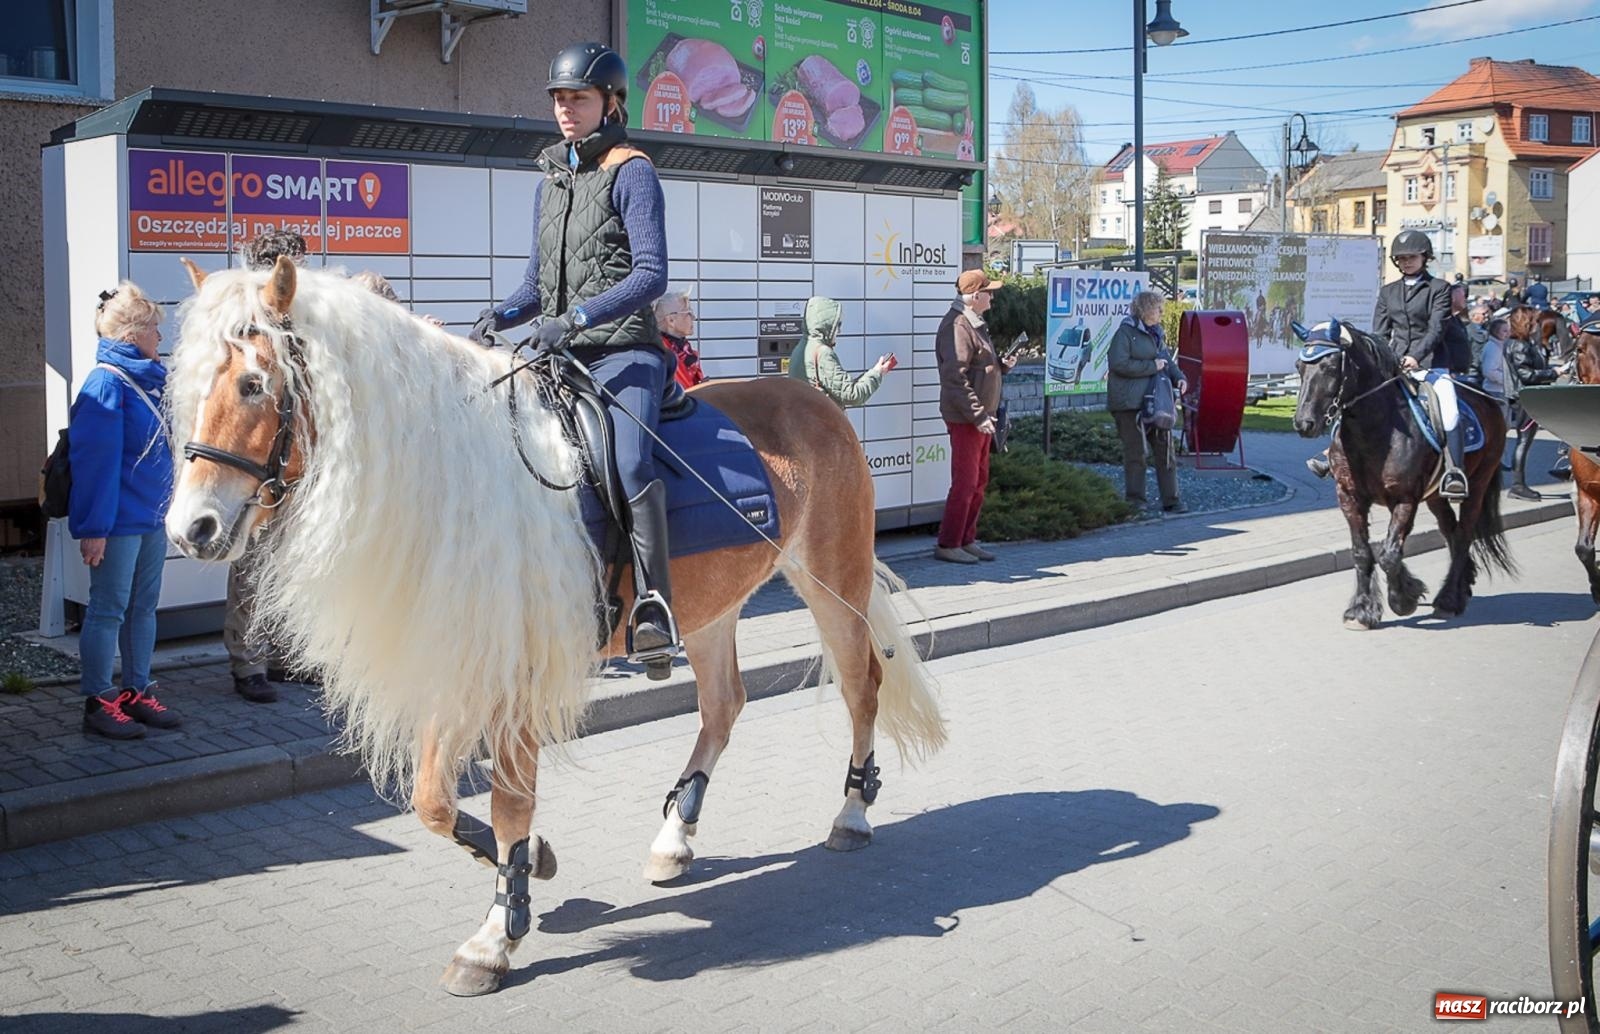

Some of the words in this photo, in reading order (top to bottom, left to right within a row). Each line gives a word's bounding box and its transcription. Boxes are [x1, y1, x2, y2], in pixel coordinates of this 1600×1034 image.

[887, 1, 908, 13] ŚRODA
[147, 159, 263, 207] allegro
[137, 215, 248, 239] Oszczędzaj
[344, 224, 402, 241] paczce
[795, 239, 810, 248] 10%
[1208, 243, 1263, 254] WIELKANOCNA
[1263, 245, 1298, 257] POCESJA
[899, 242, 946, 265] InPost
[1208, 256, 1254, 268] PIETROWICE
[922, 268, 933, 276] the
[934, 268, 946, 276] box
[1075, 278, 1142, 300] SZKOŁA
[1075, 303, 1109, 316] NAUKI
[1111, 304, 1129, 316] JAZ
[866, 452, 911, 469] komat
[915, 443, 946, 464] 24h
